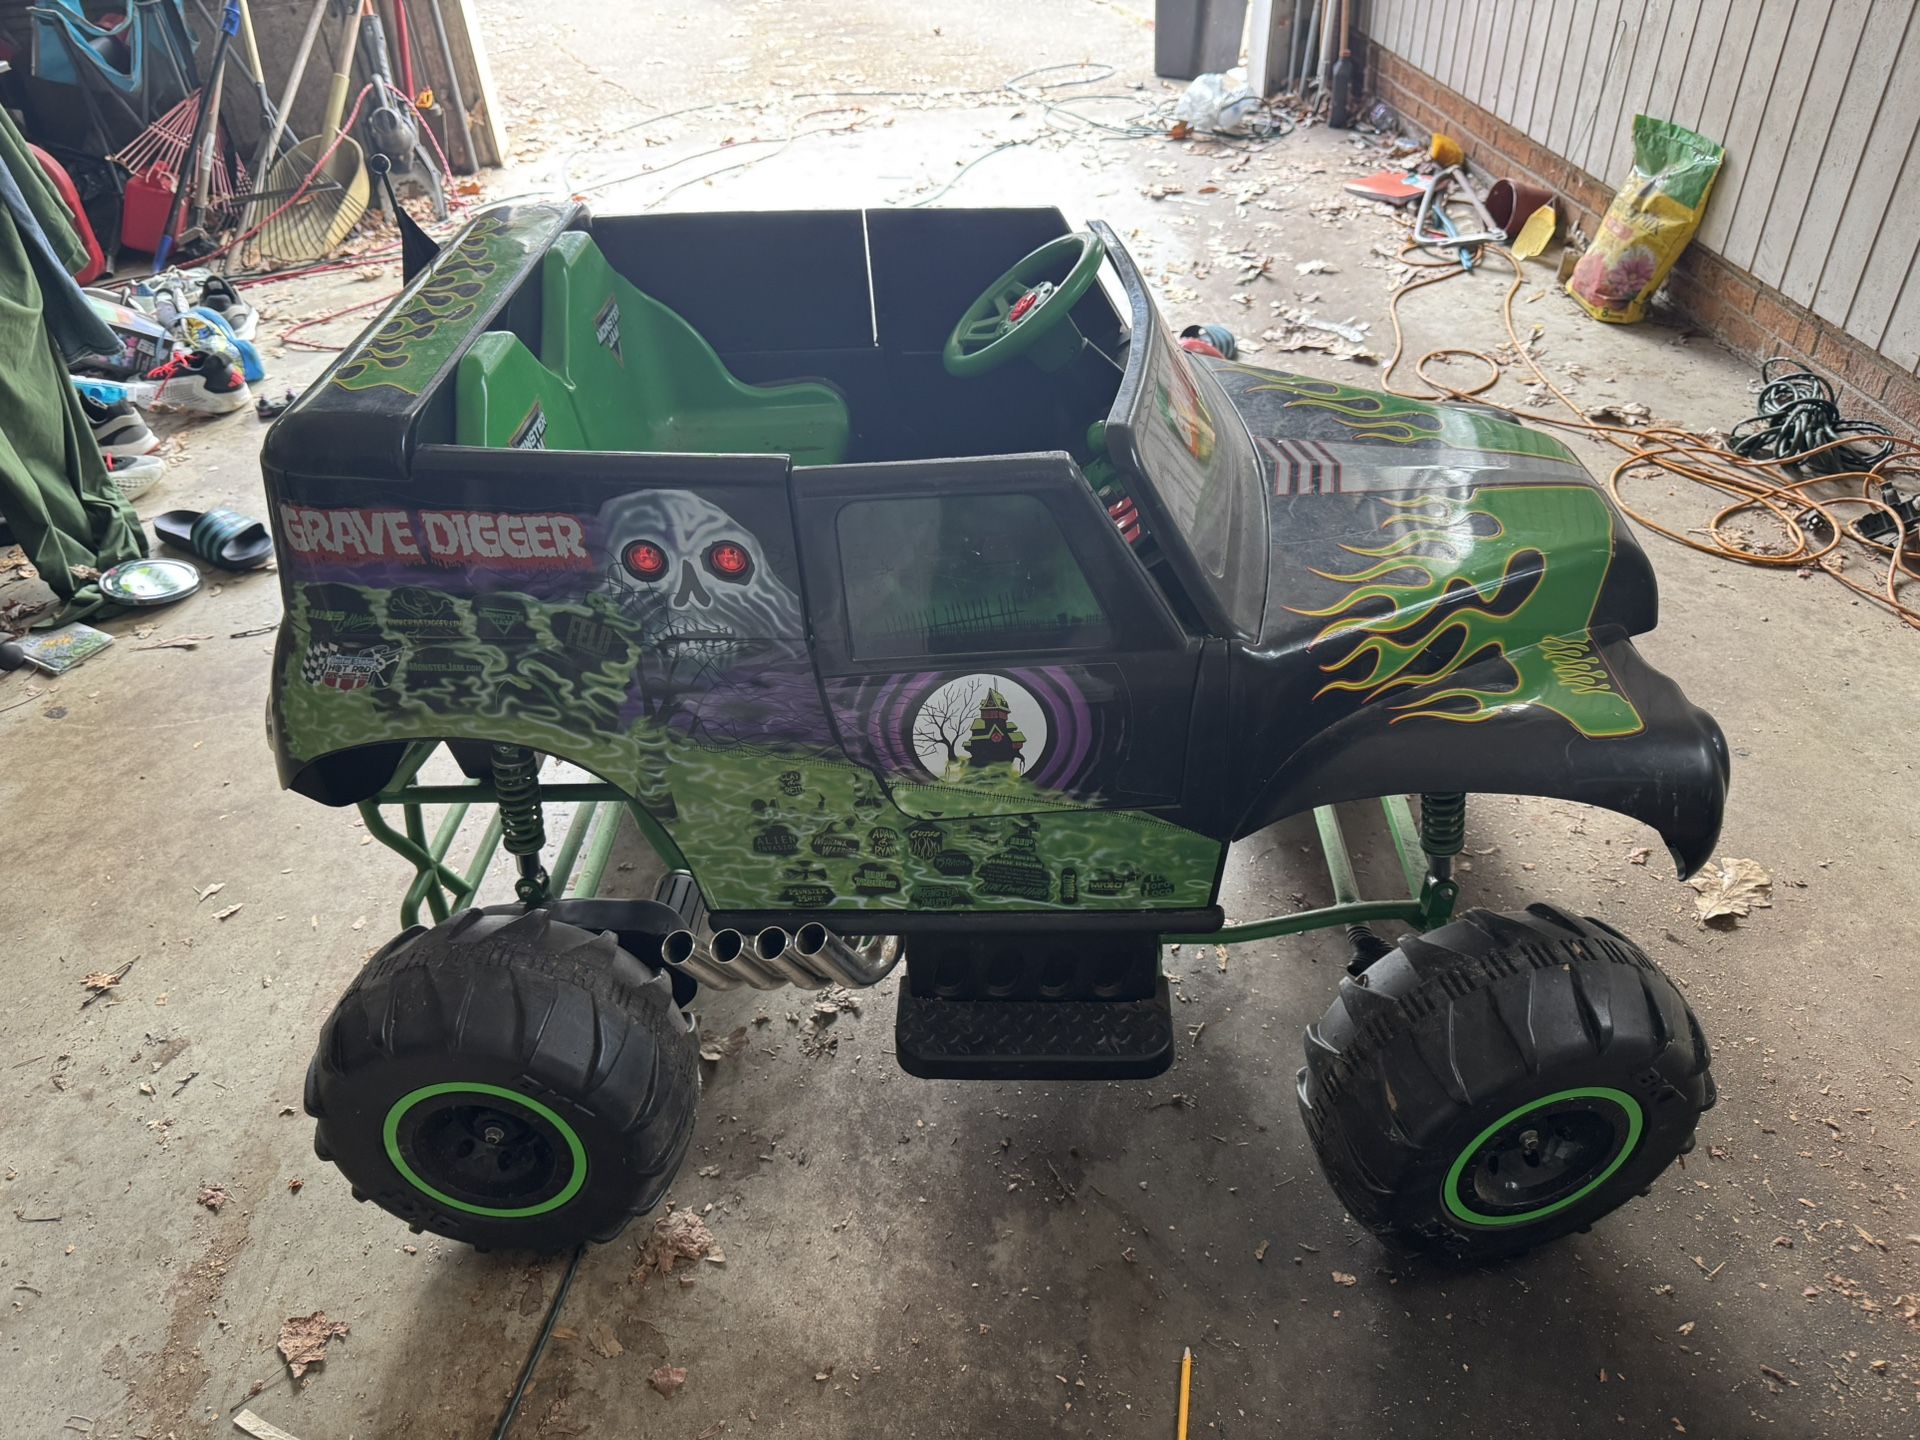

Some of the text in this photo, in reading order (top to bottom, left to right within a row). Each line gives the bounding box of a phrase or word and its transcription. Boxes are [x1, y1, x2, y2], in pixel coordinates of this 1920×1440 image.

[595, 303, 620, 346] MONSTER
[608, 325, 620, 349] JAM
[519, 411, 547, 449] NSTER
[280, 505, 588, 560] GRAVE DIGGER
[327, 664, 349, 673] HOT
[756, 835, 797, 846] ALIEN
[872, 829, 897, 841] ADAM
[874, 845, 896, 857] RYAN
